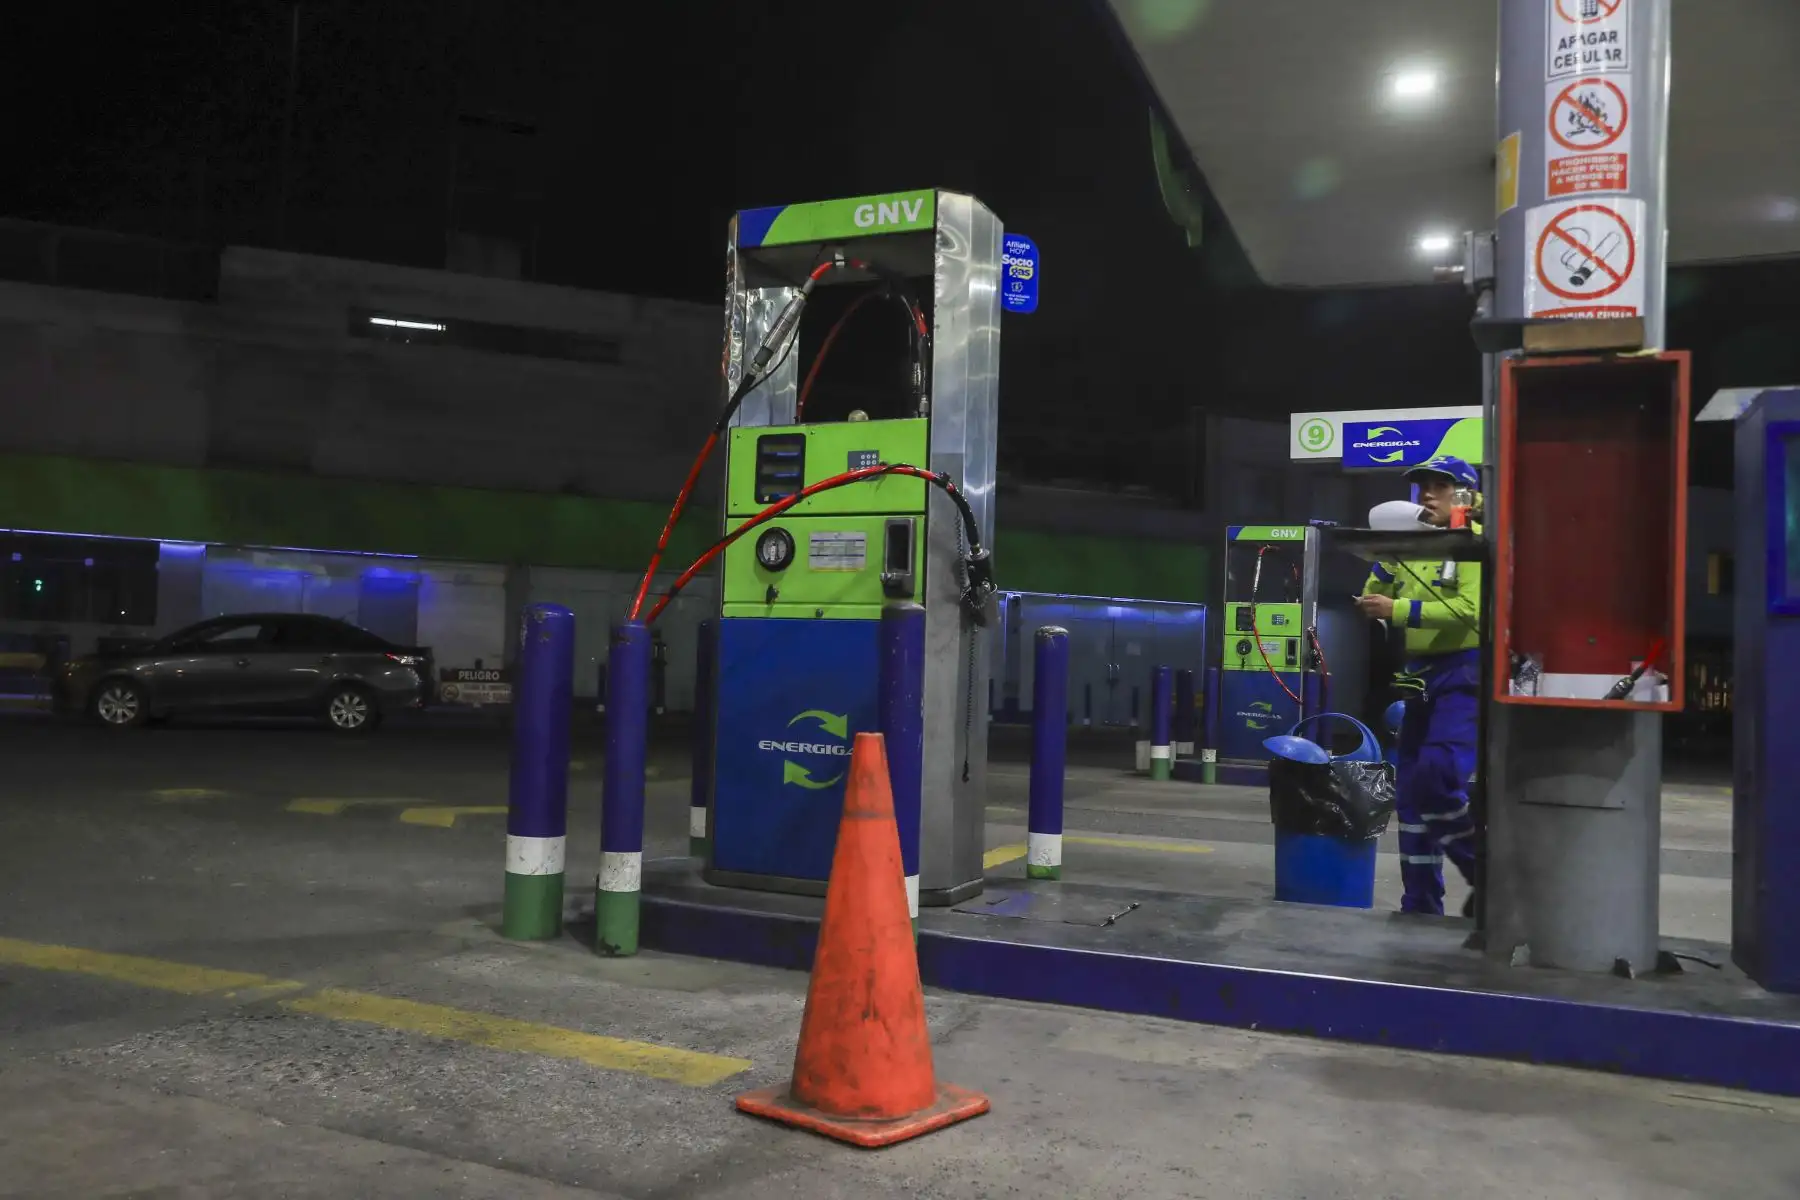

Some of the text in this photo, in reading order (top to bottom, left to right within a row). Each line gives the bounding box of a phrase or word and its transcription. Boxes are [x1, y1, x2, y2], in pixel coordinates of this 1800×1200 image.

[1558, 31, 1618, 50] APAGAR
[854, 198, 924, 228] GNV
[1009, 247, 1026, 255] HOY
[1001, 254, 1034, 267] Socio
[1010, 267, 1031, 278] gas
[1308, 425, 1325, 446] 9
[1352, 440, 1420, 448] ENERGIGAS
[1271, 528, 1298, 538] GNV
[458, 670, 500, 681] PELIGRO
